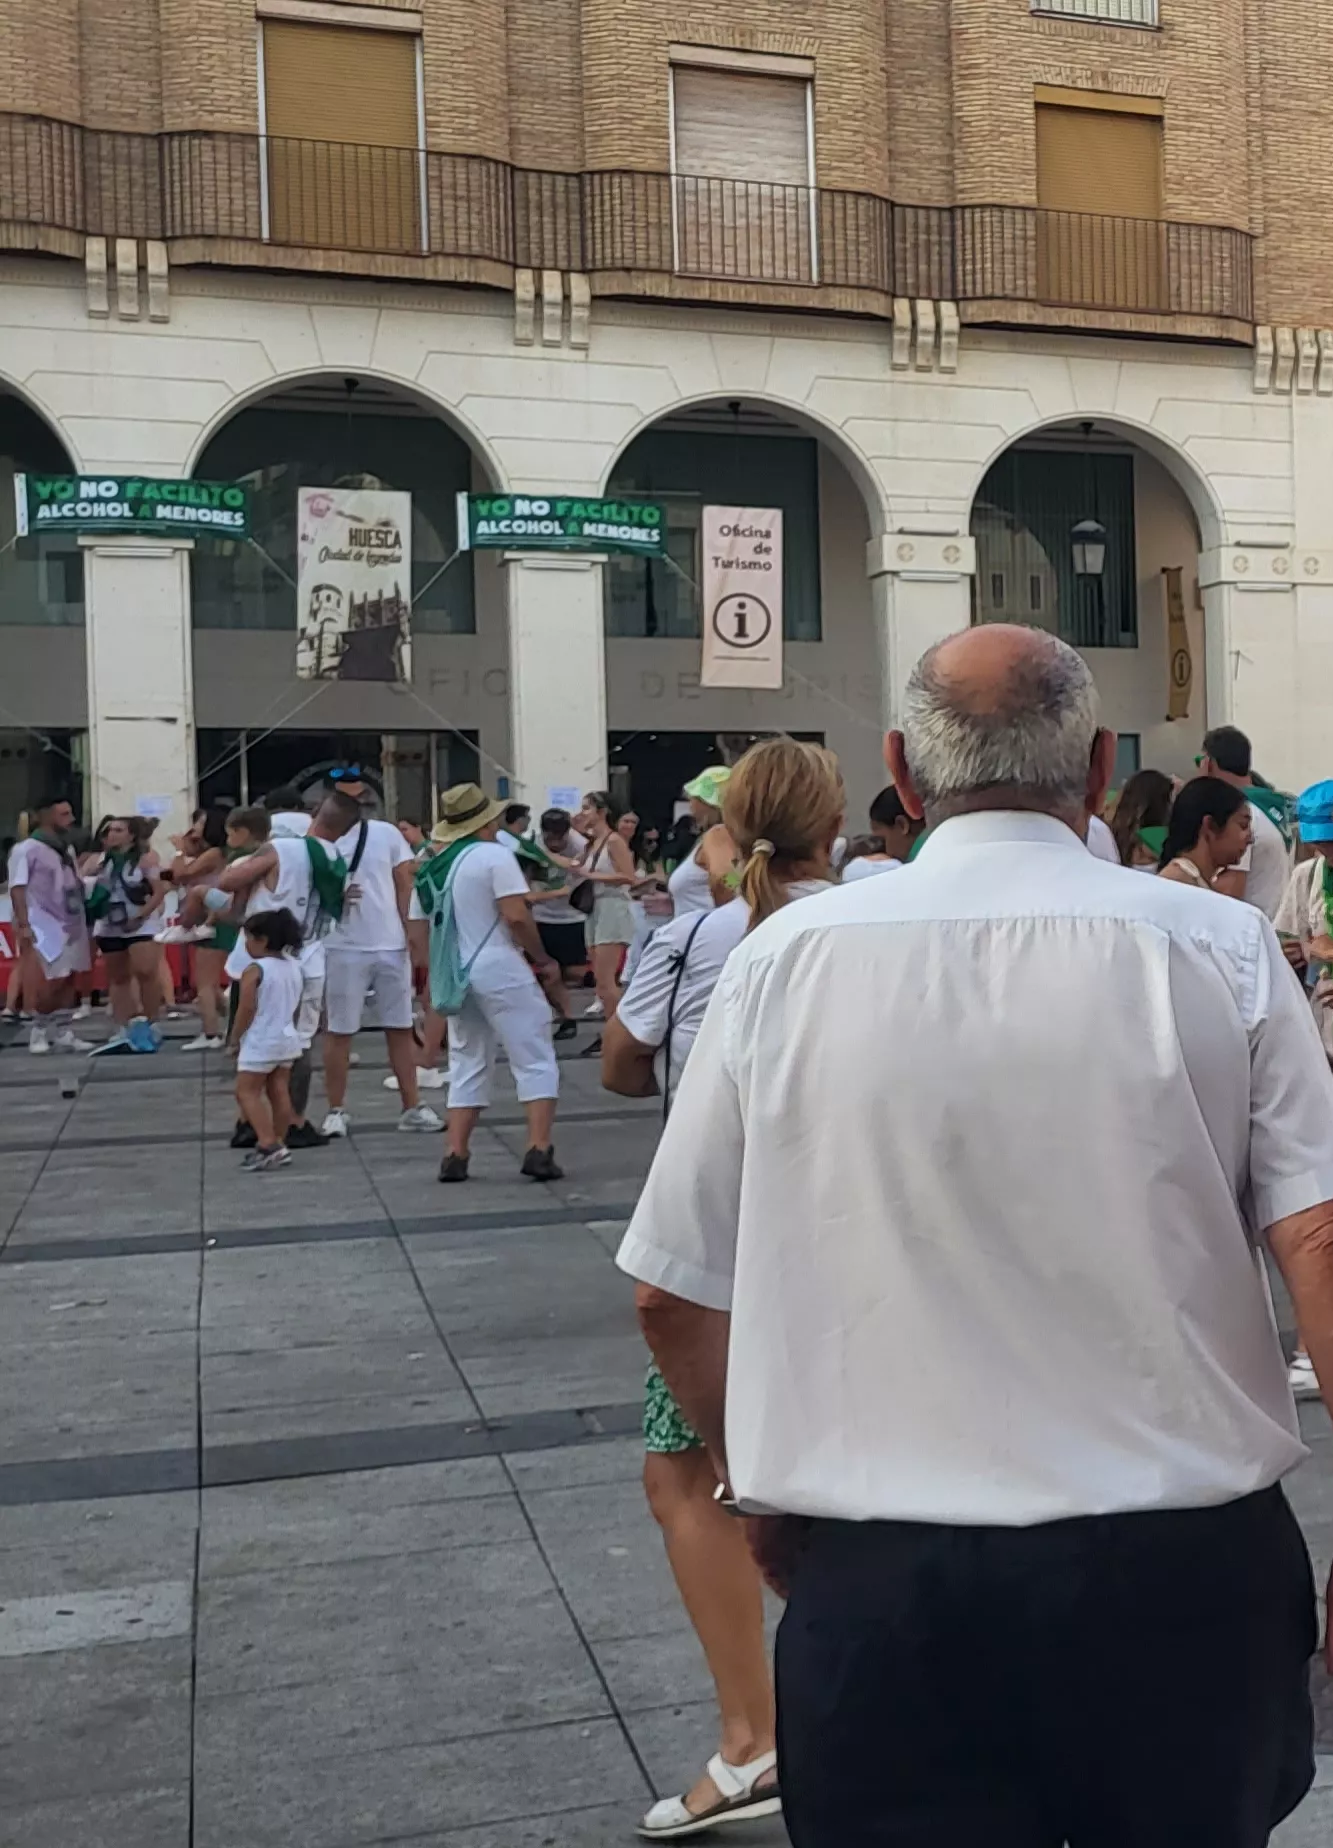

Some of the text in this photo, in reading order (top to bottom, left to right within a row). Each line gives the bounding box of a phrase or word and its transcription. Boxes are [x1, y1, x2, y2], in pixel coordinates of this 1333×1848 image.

[35, 480, 244, 507] YO NO FACILITO
[37, 502, 133, 519] ALCOHOL
[138, 506, 152, 518] A
[156, 505, 245, 526] MENORES
[476, 499, 661, 524] YO NO FACILITO
[349, 527, 402, 548] HUESCA
[476, 520, 564, 535] ALCOHOL
[567, 522, 581, 535] A
[583, 523, 661, 542] MENORES
[719, 524, 772, 539] Oficina
[753, 542, 773, 555] de
[712, 556, 773, 571] Turismo
